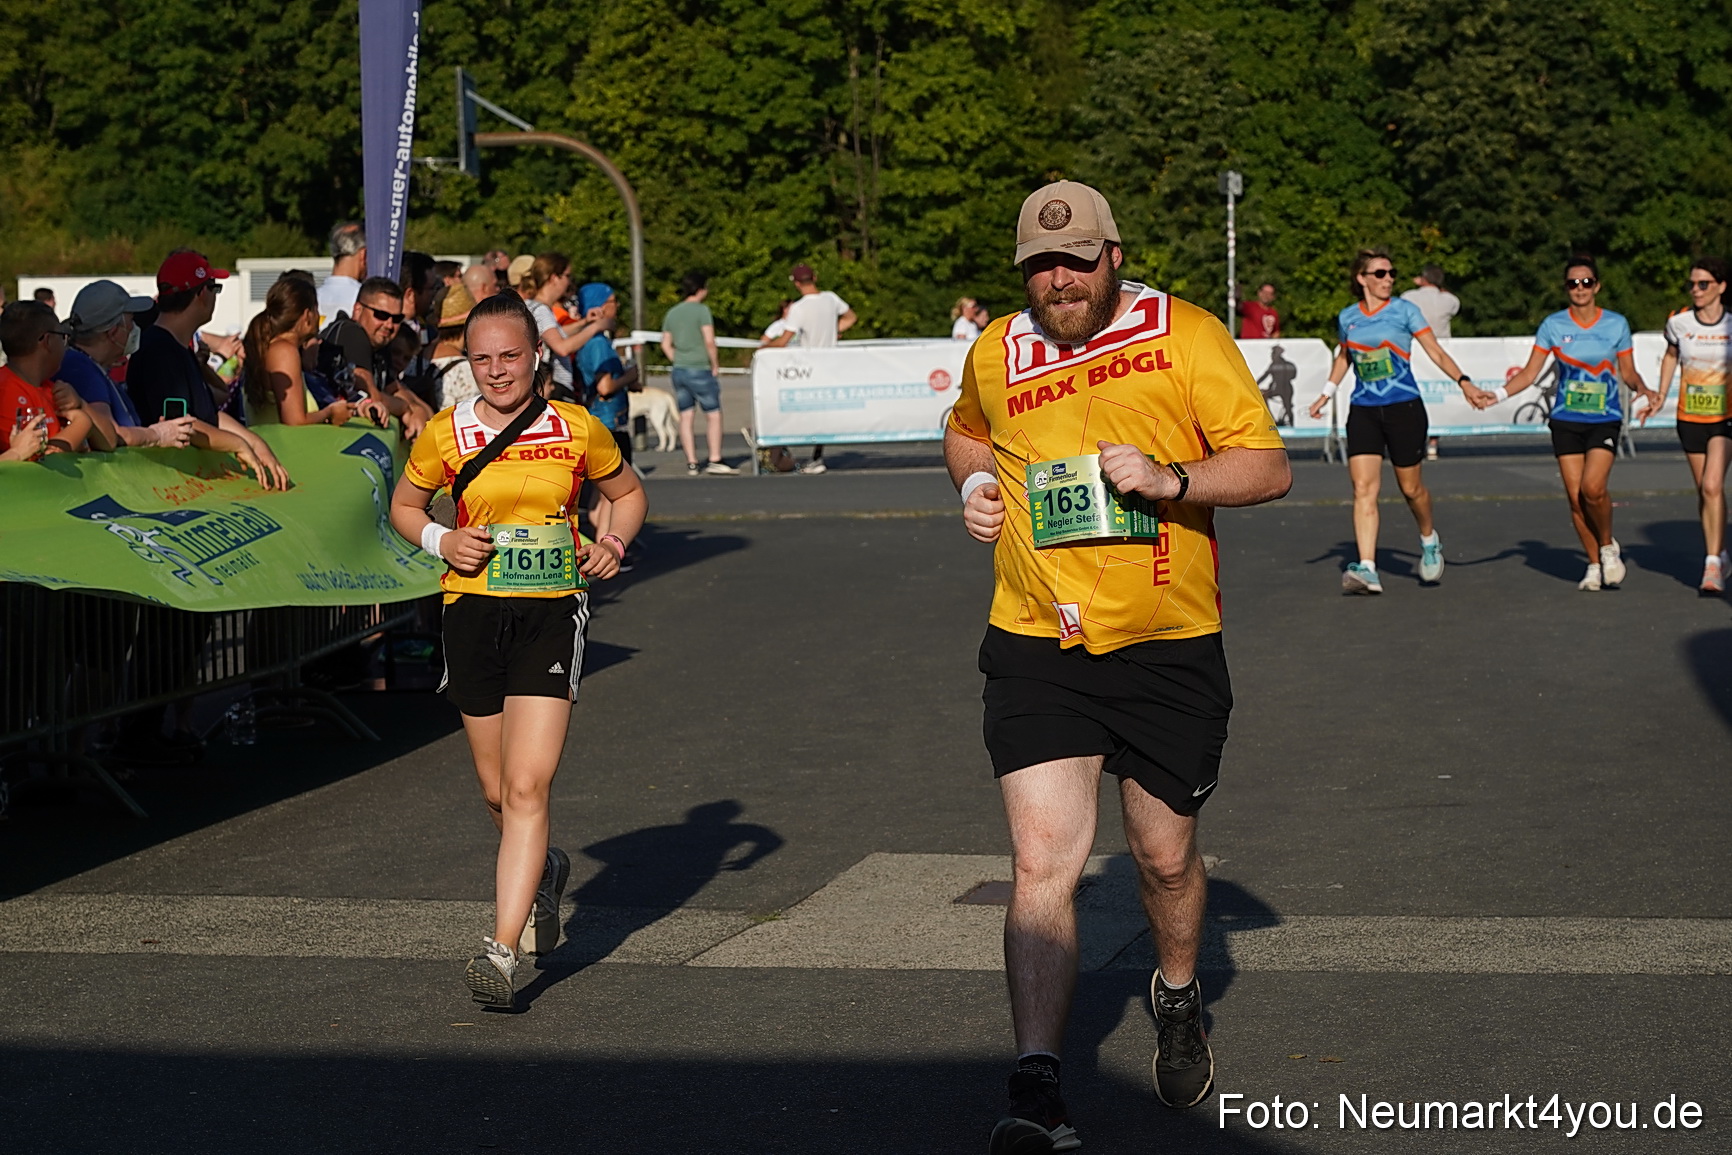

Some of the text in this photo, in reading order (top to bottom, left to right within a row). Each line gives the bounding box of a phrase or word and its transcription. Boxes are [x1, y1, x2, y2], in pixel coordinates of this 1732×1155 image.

[777, 367, 812, 380] NOW
[1007, 349, 1173, 418] MAX BÖGL
[781, 389, 833, 402] E-BIKES
[1692, 395, 1720, 405] 1097
[519, 445, 576, 461] BÖGL
[1049, 470, 1078, 483] Firmenlauf
[1043, 484, 1111, 517] 1639
[1034, 501, 1045, 530] RUN
[1047, 516, 1073, 529] Negler
[492, 554, 501, 578] RUN
[503, 547, 563, 571] 1613
[564, 549, 572, 580] 2022
[502, 571, 563, 580] Hofmann Lena
